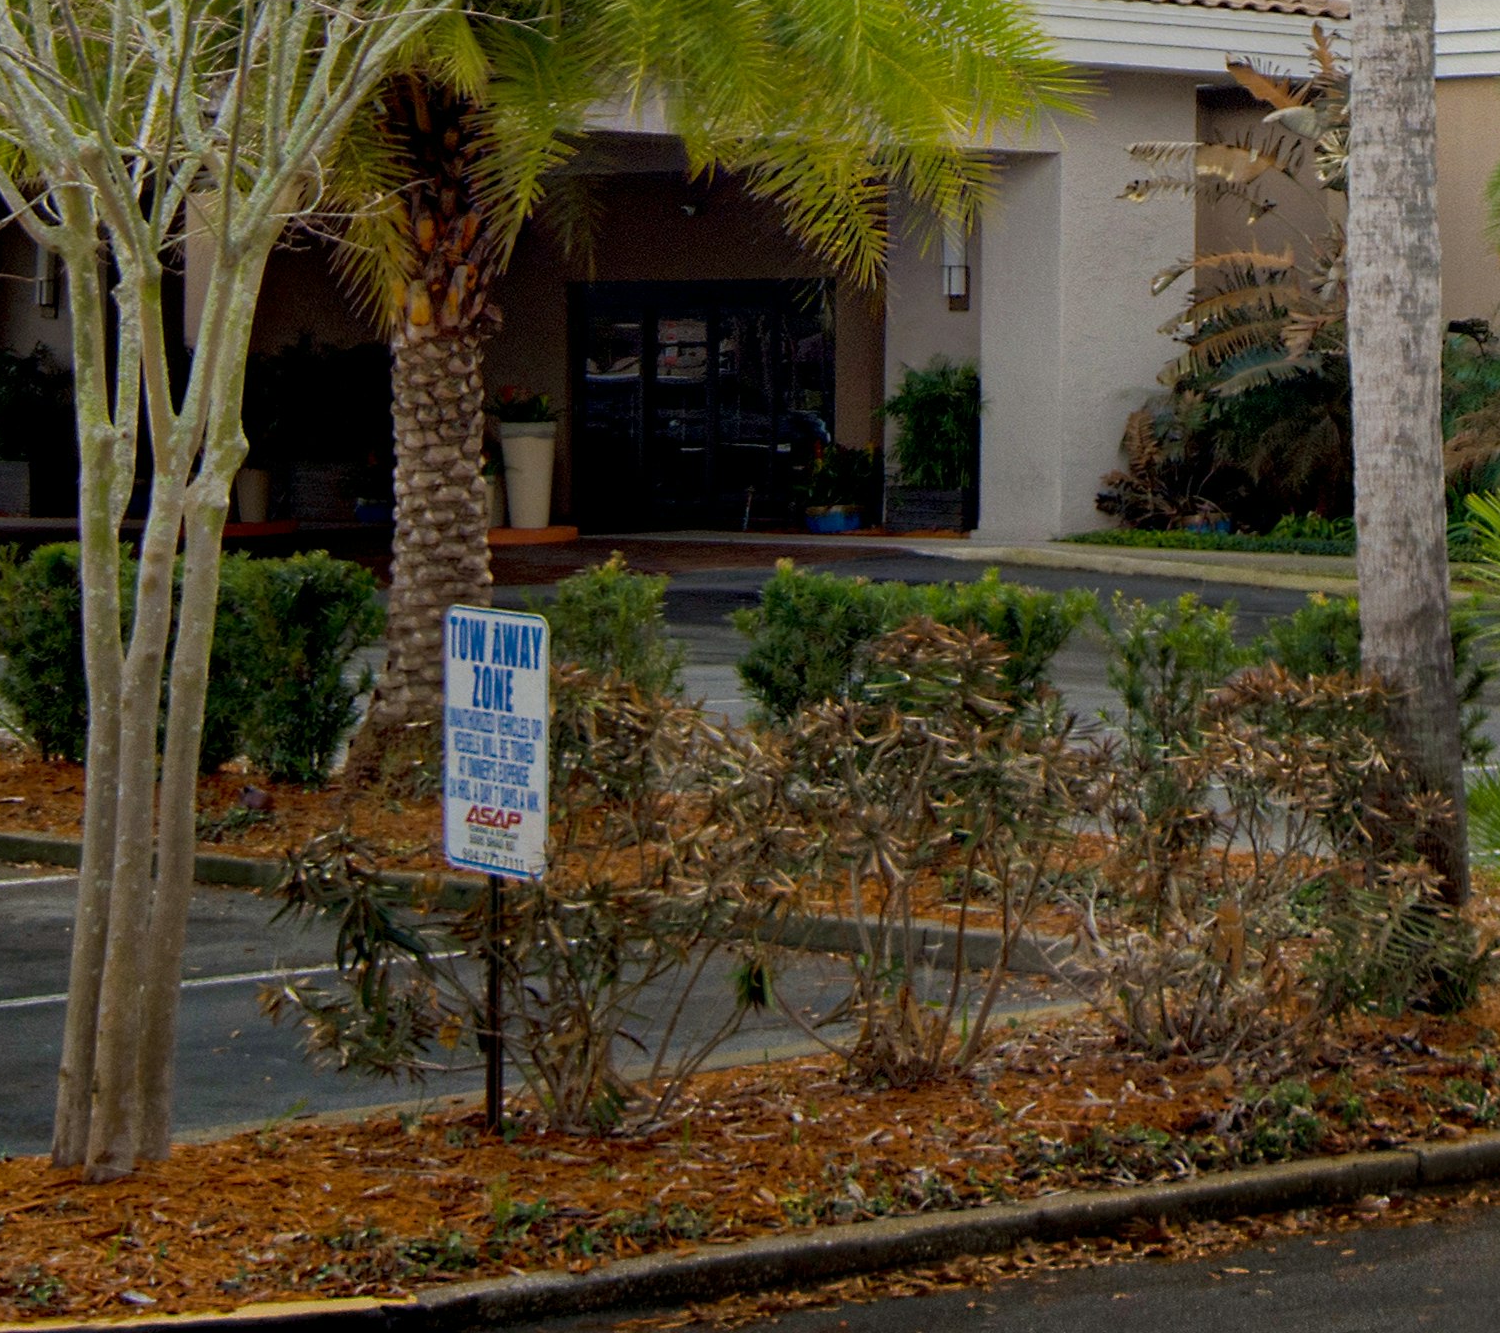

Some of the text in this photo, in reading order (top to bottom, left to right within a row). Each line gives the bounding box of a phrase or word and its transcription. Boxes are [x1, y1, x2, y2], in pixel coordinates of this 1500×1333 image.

[450, 616, 543, 670] TOW AWAY
[472, 665, 514, 712] ZONE
[466, 805, 522, 829] ASAP
